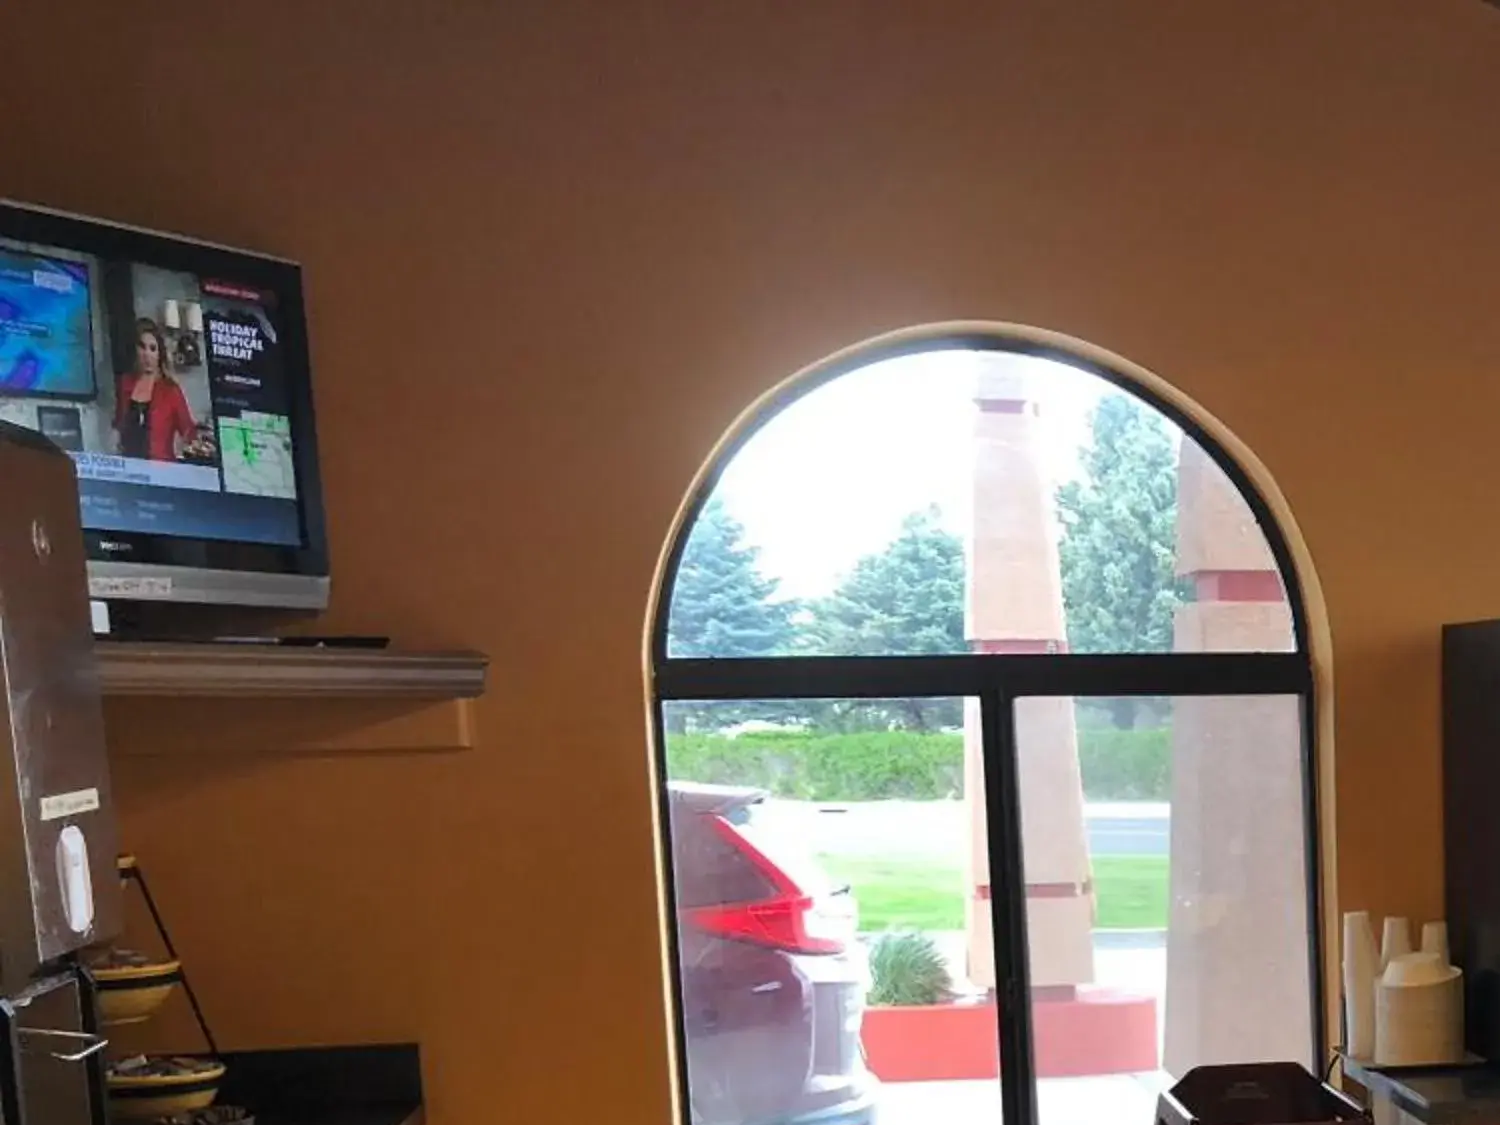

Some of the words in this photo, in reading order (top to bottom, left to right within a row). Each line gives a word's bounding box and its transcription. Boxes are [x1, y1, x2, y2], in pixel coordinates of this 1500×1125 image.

[209, 320, 258, 338] HOLIDAY
[211, 331, 264, 352] TROPICAL
[213, 343, 253, 361] THREAT
